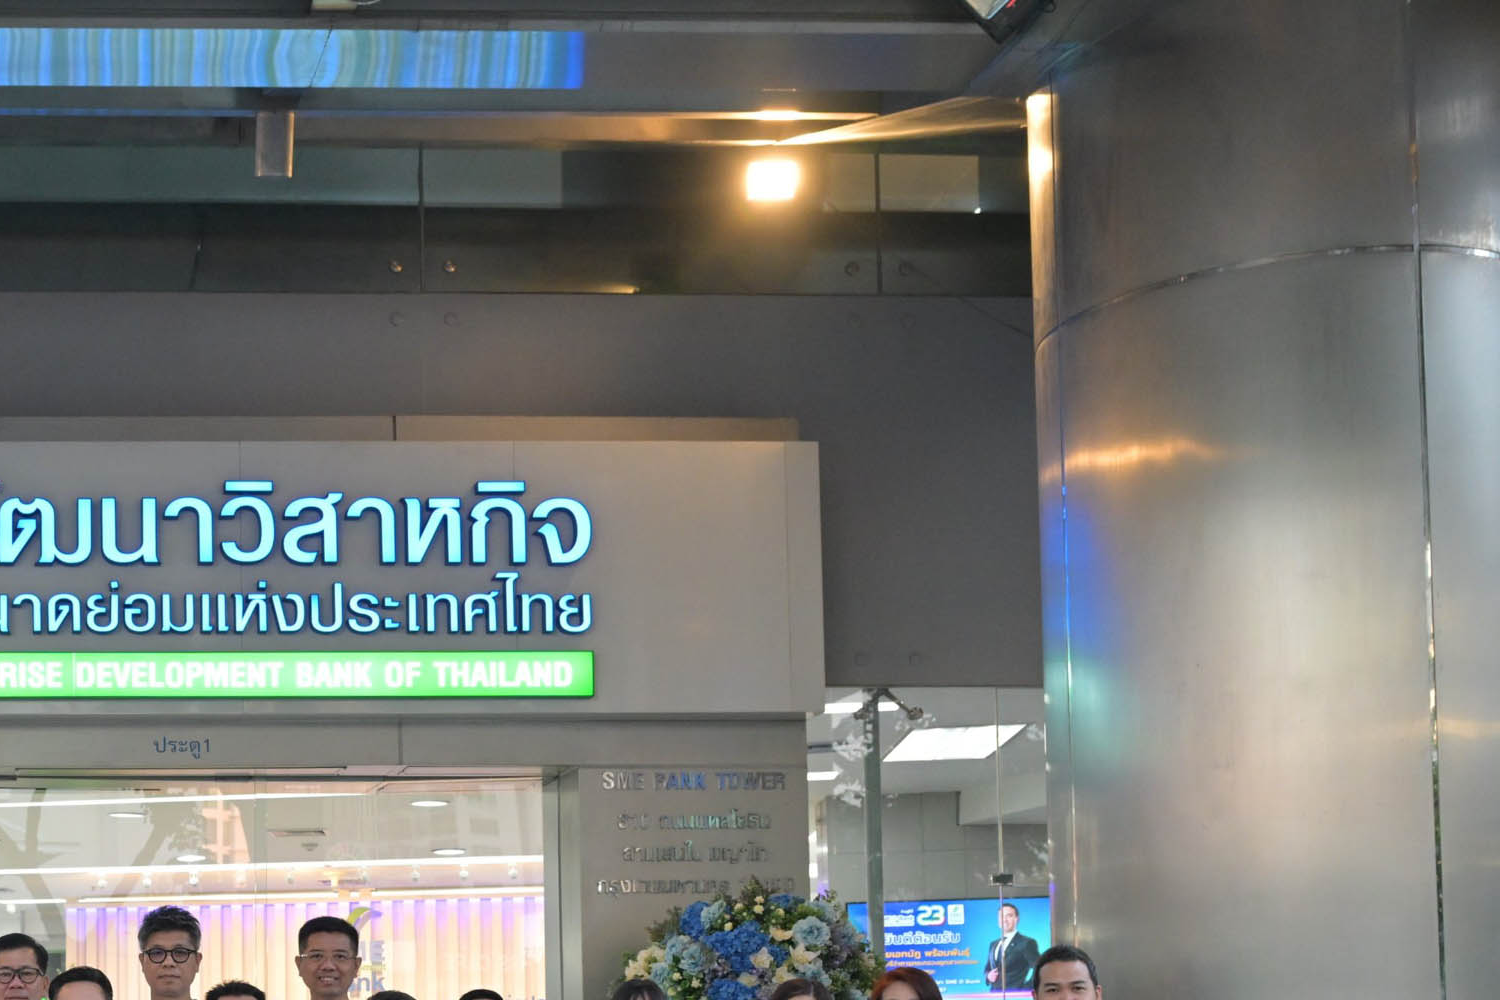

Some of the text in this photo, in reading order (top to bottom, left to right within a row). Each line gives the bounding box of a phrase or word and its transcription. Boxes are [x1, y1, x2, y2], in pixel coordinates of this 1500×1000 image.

[75, 661, 284, 690] DEVELOPMENT
[297, 661, 373, 690] BANK
[384, 661, 421, 690] OF
[435, 661, 574, 690] THAILAND
[152, 736, 210, 760] ประตู1
[602, 772, 645, 790] SME
[715, 772, 787, 791] TOWER
[916, 904, 946, 927] 23
